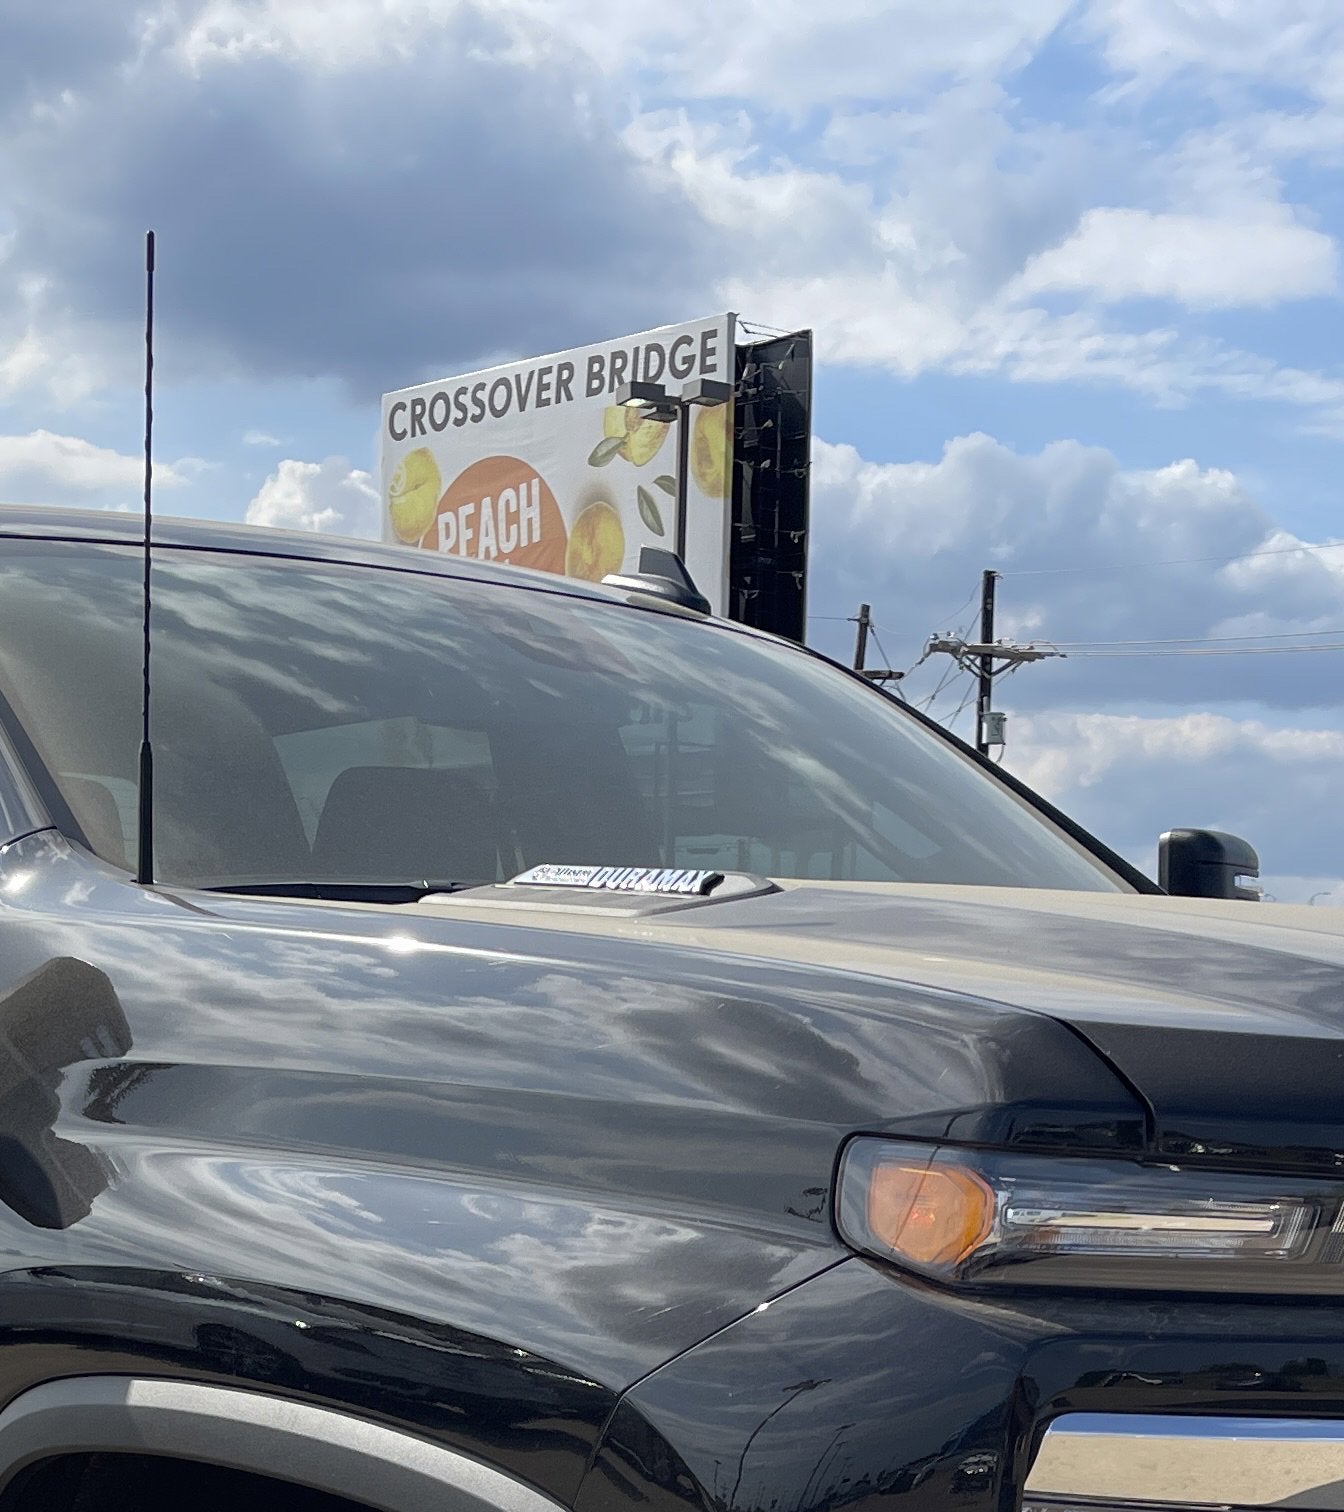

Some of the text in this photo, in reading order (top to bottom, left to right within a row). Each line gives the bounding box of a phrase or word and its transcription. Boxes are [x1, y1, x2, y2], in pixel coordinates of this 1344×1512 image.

[388, 328, 718, 441] CROSSOVER BRIDGE
[588, 865, 718, 893] DURAMAX
